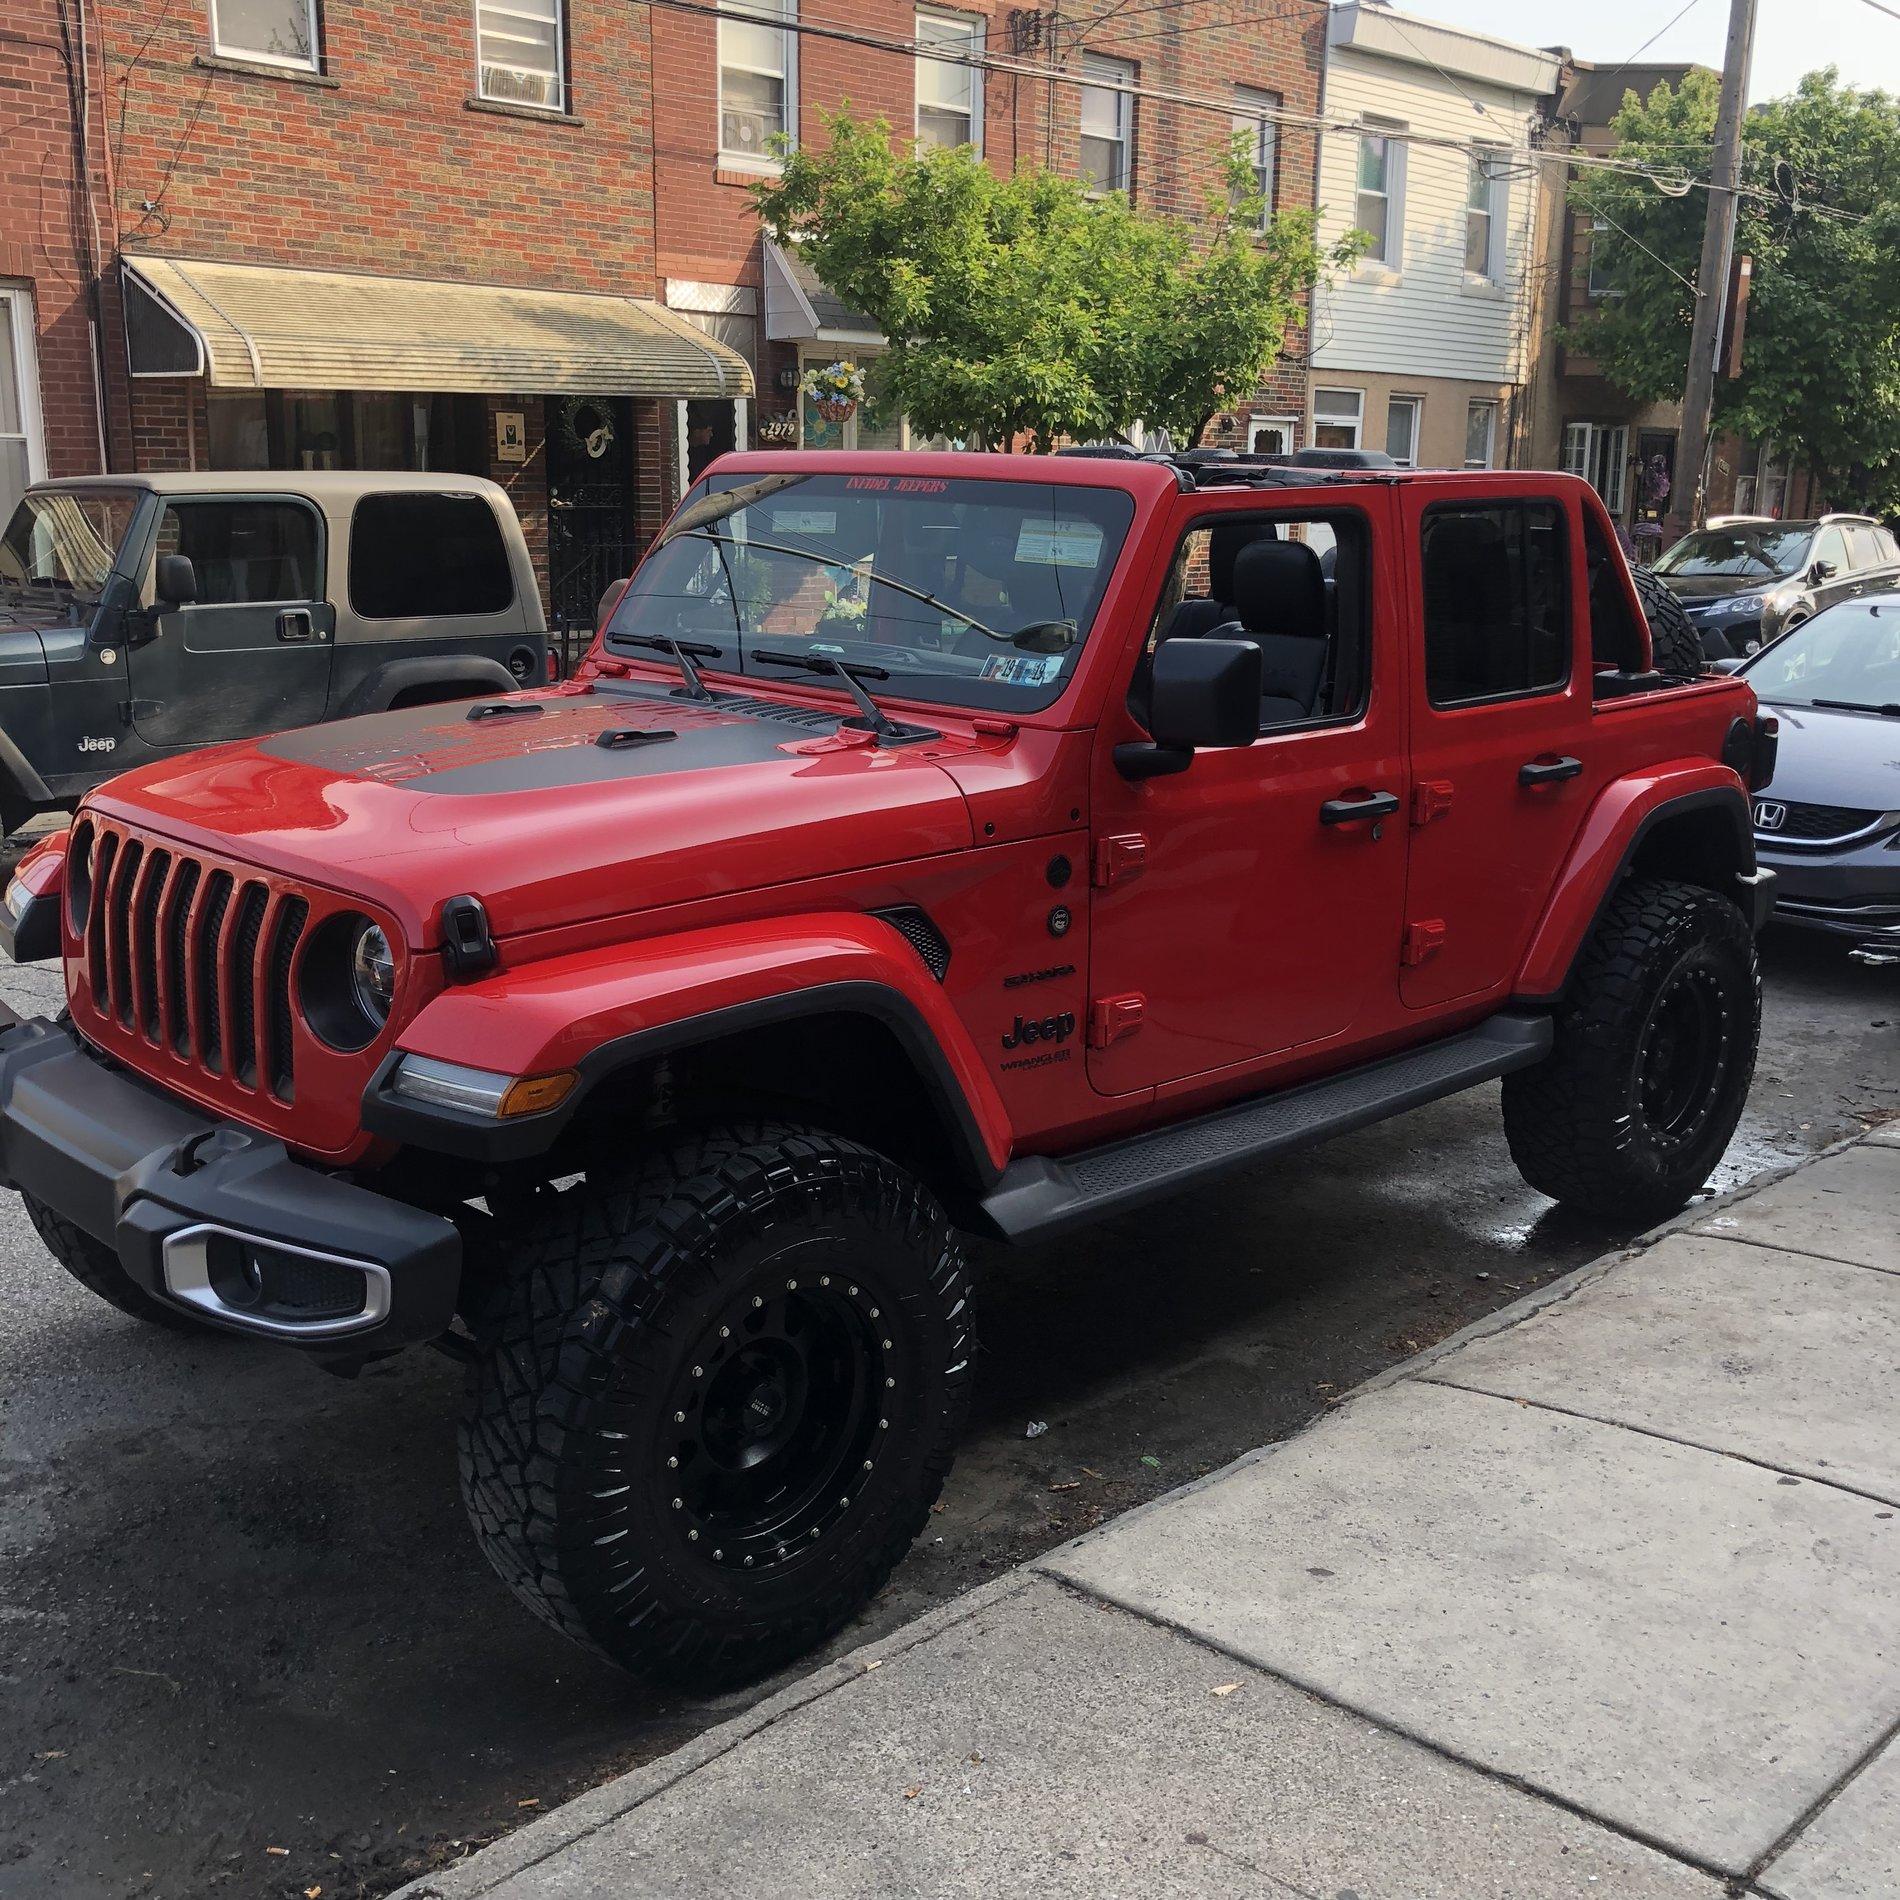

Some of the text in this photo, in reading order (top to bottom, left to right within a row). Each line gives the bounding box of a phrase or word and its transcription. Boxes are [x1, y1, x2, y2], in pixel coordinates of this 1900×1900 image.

[767, 422, 795, 436] 2979
[893, 479, 949, 493] JEEPERS
[1001, 658, 1016, 677] 19
[1031, 662, 1047, 680] 19
[77, 736, 117, 753] Jeep
[1001, 1011, 1076, 1049] Jeep
[999, 1048, 1072, 1071] WRANGLER
